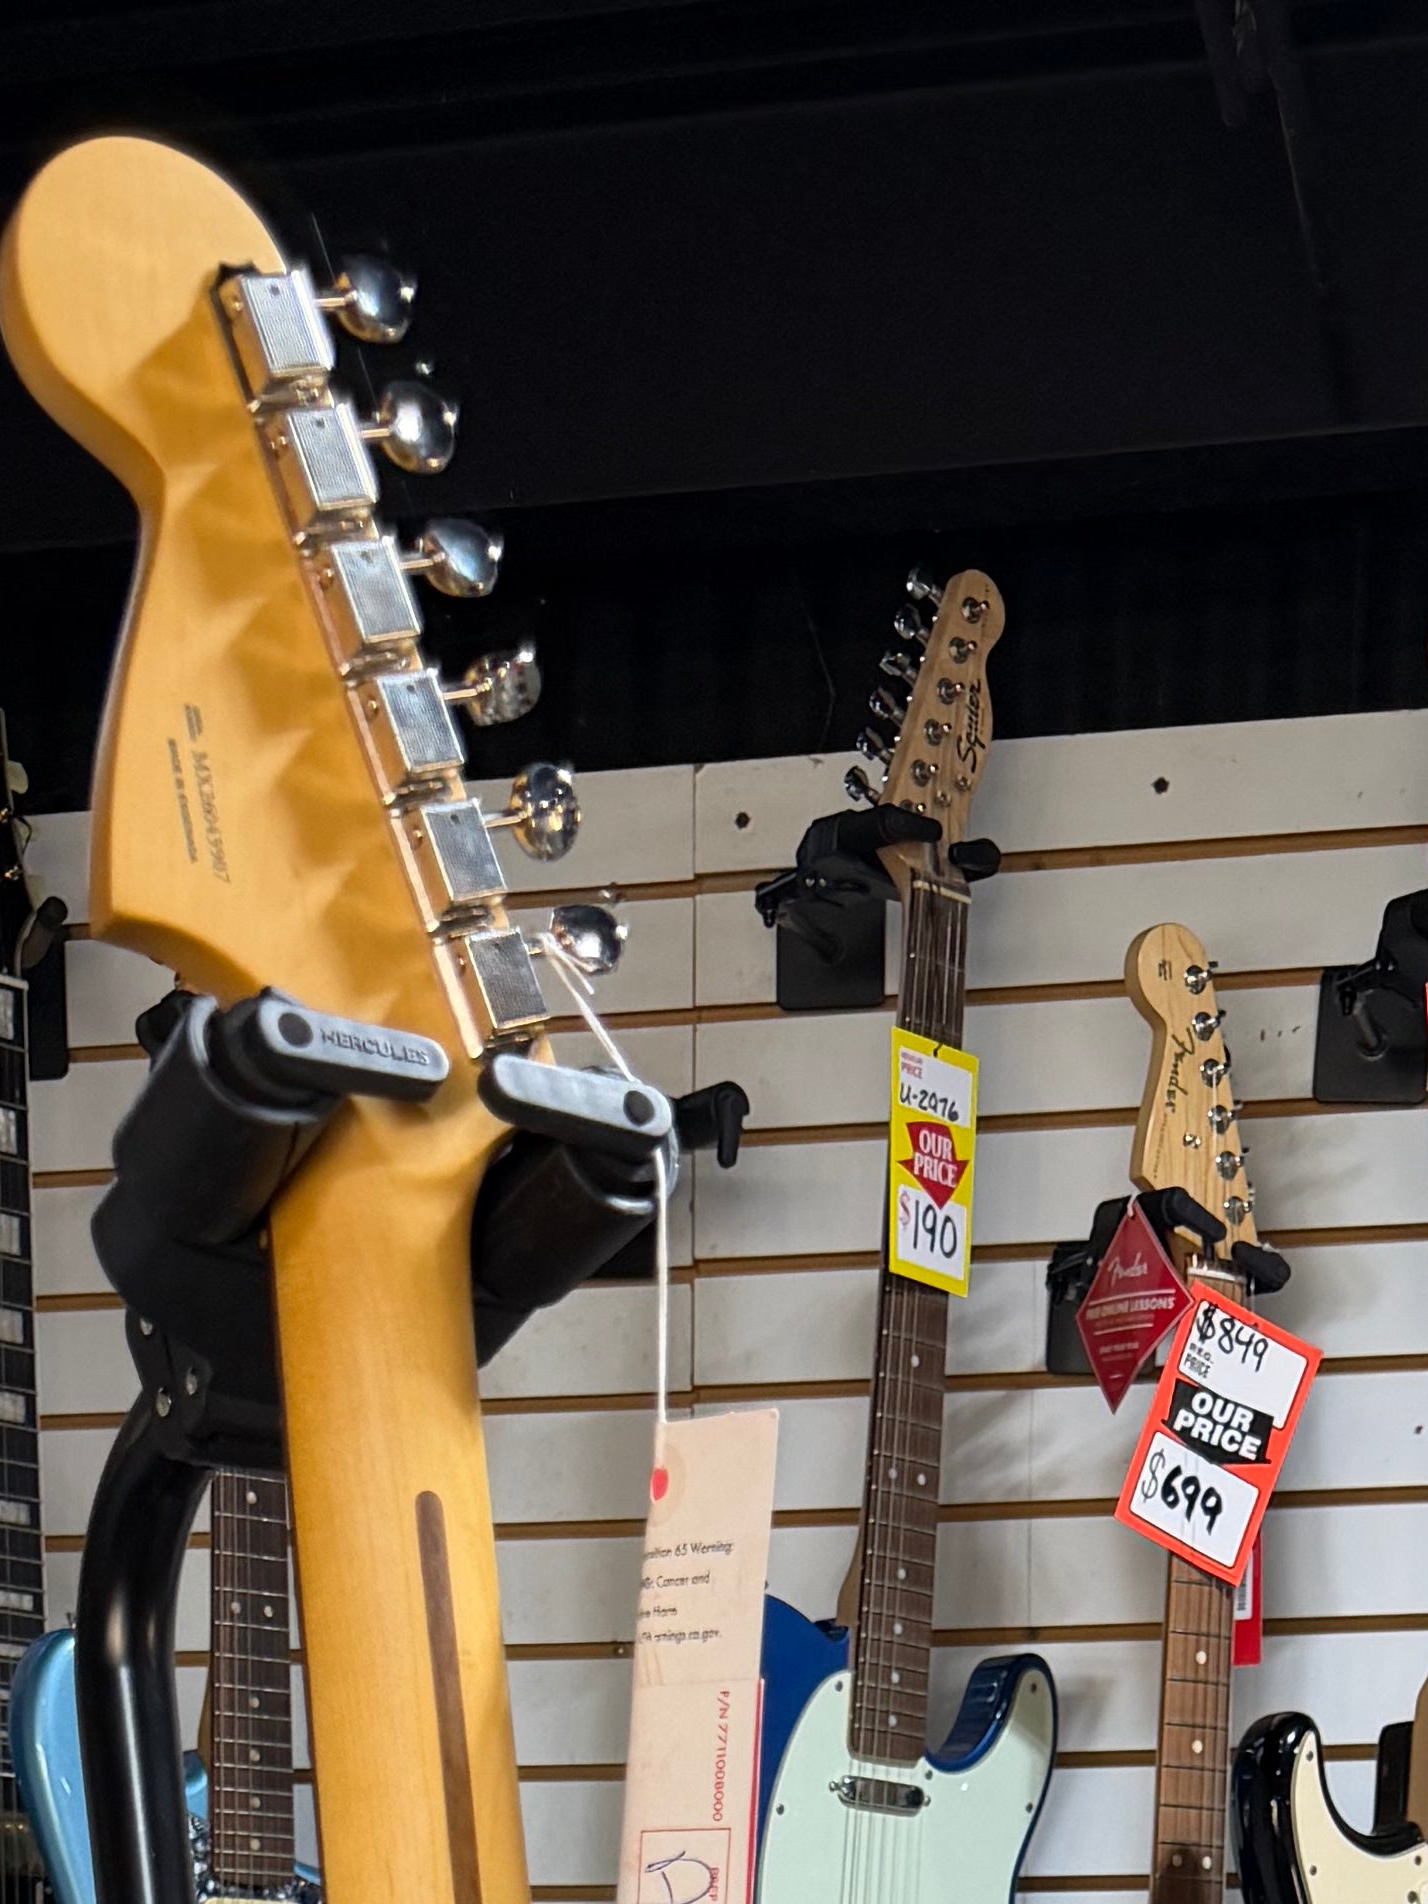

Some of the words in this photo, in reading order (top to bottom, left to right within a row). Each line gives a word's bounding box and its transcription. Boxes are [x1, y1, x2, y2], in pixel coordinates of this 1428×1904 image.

[957, 678, 986, 775] Squier
[319, 1028, 429, 1068] HERCULES
[900, 1062, 923, 1080] PRICE
[1165, 1027, 1195, 1114] Fender
[918, 1129, 953, 1161] OUR
[913, 1153, 958, 1189] PRICE
[898, 1190, 958, 1259] $190
[1107, 1252, 1149, 1287] Fender
[1130, 1296, 1176, 1313] LESSONS
[1196, 1302, 1269, 1373] $849
[1183, 1353, 1213, 1380] PRICE
[1191, 1391, 1254, 1433] OUR
[1173, 1408, 1262, 1461] PRICE
[1140, 1448, 1224, 1536] $699
[691, 1570, 711, 1584] and
[717, 1690, 731, 1720] P/N
[712, 1722, 729, 1822] 7711008000
